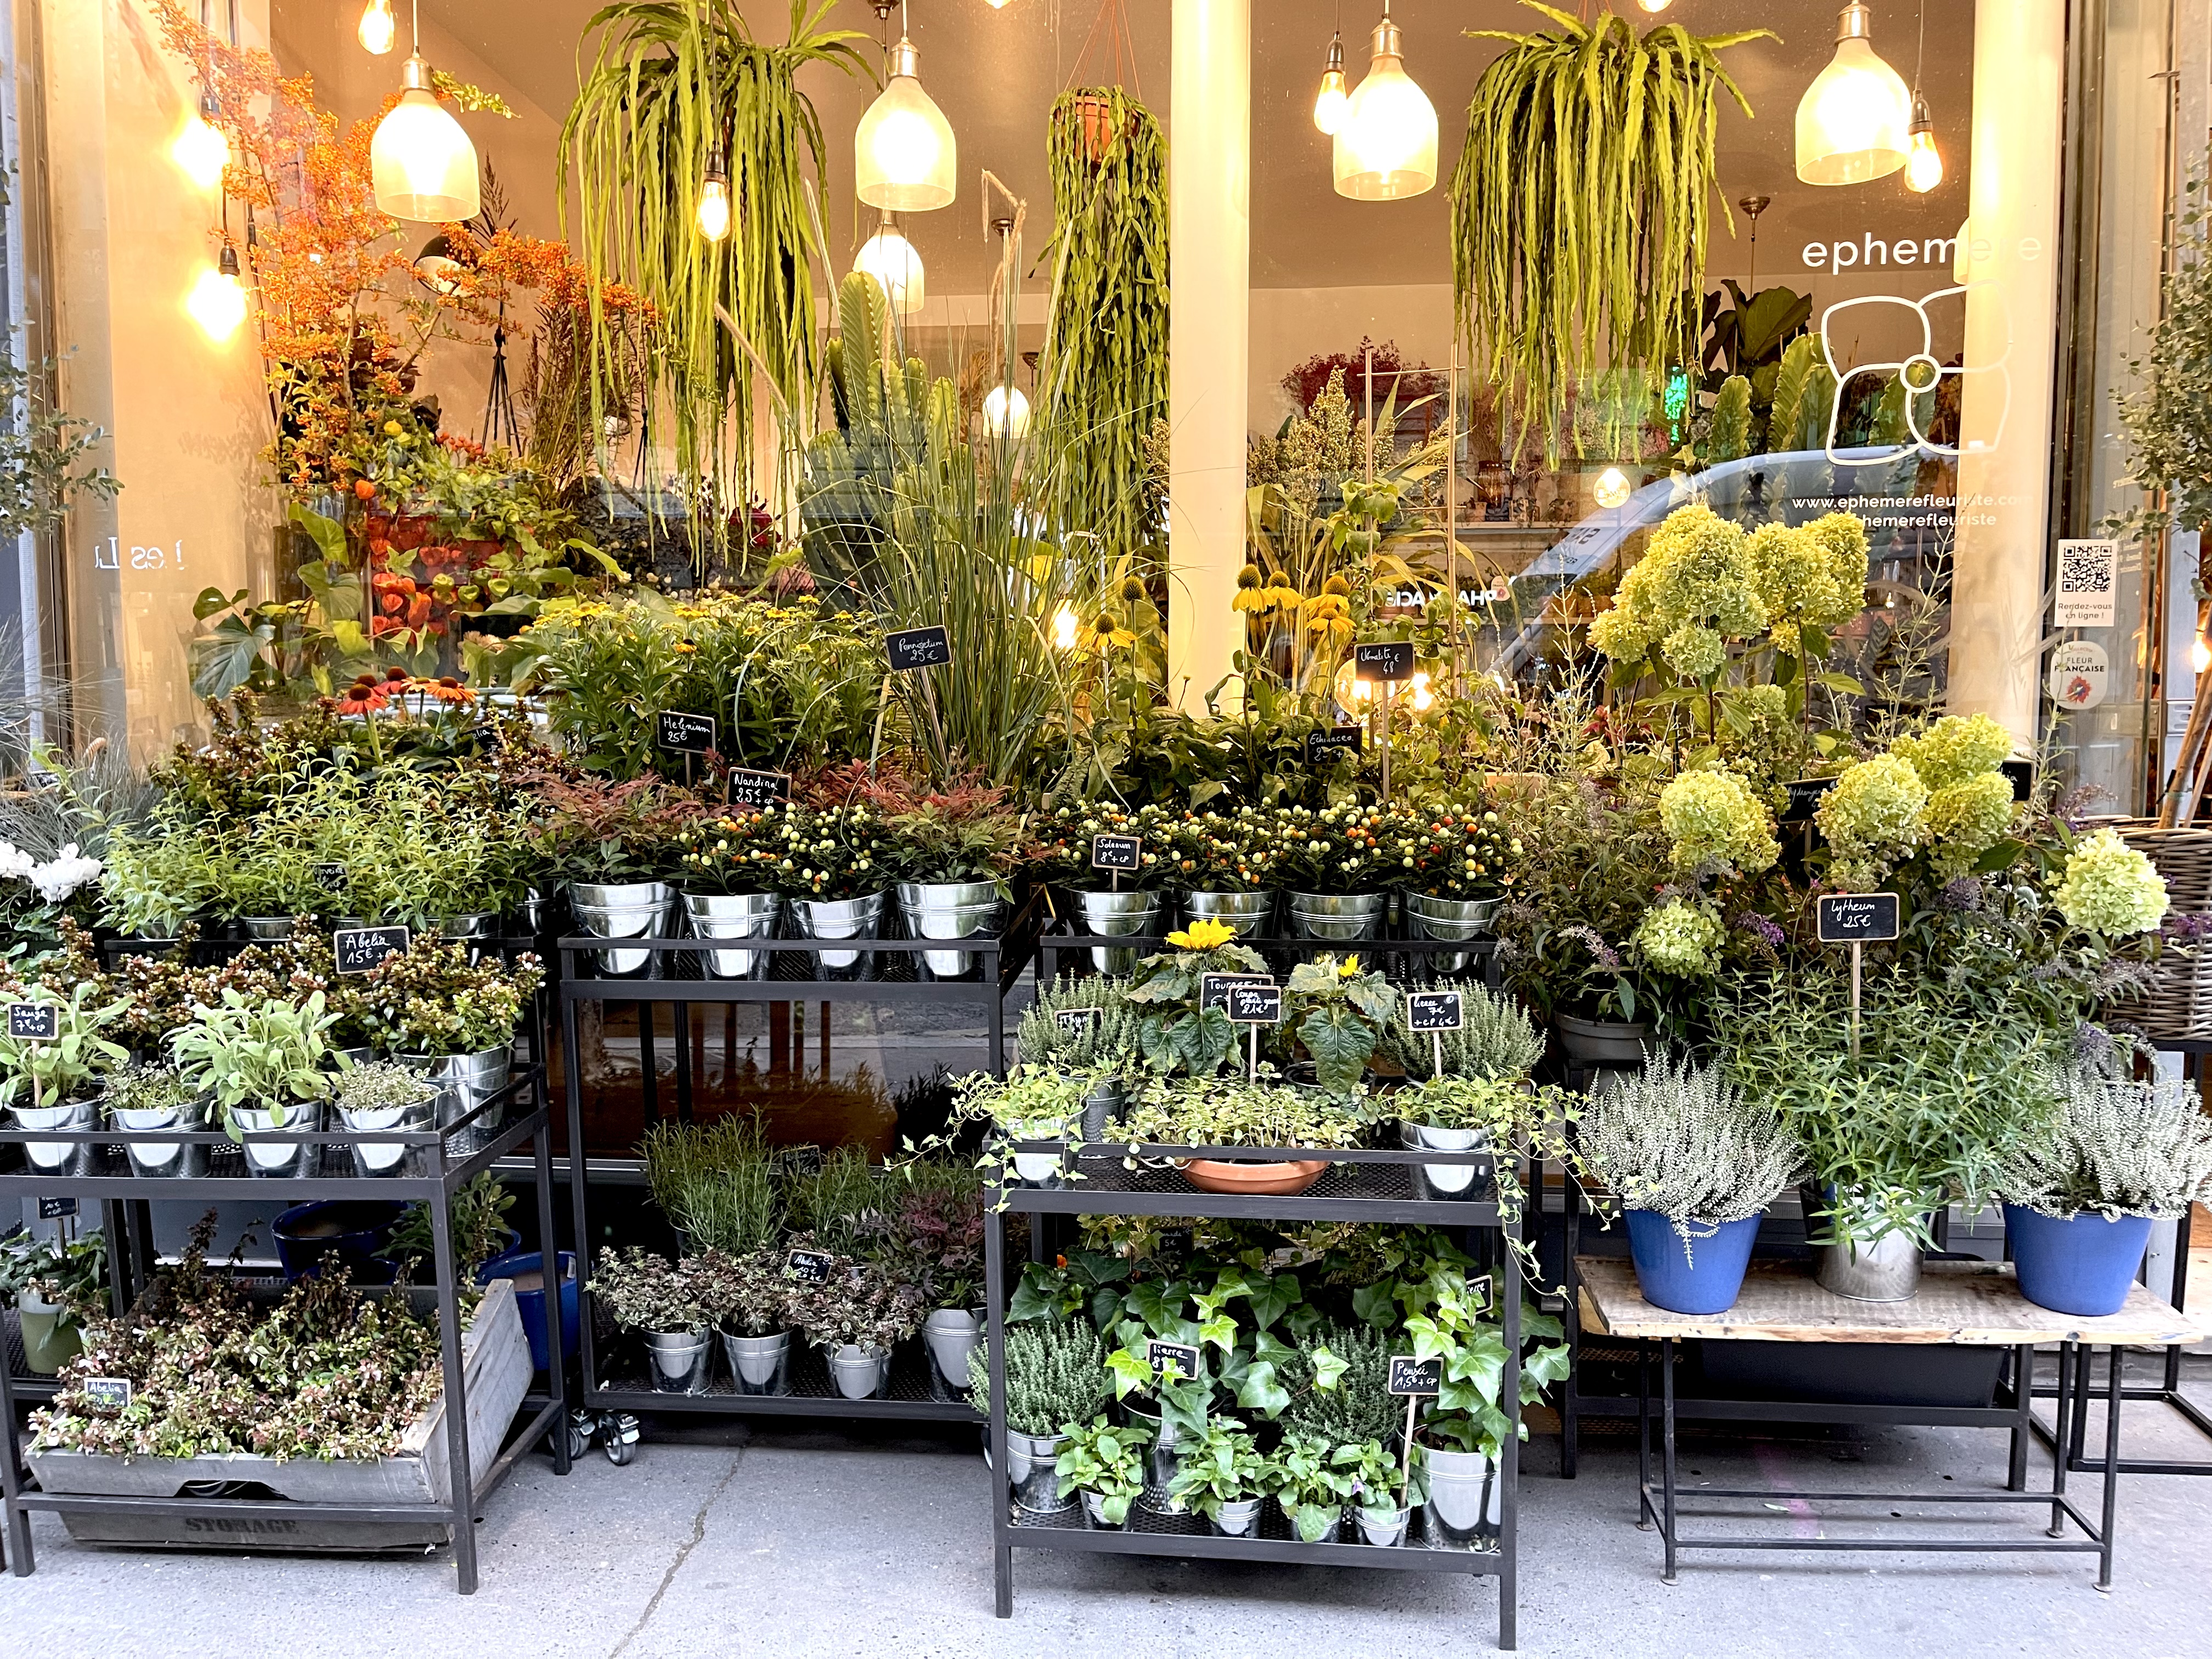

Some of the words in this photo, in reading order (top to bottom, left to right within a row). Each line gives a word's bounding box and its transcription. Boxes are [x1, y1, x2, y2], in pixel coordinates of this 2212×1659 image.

[2078, 612, 2099, 620] ligne
[668, 731, 687, 743] 25€
[734, 773, 778, 791] Nandina
[1097, 838, 1131, 849] Solanum
[1843, 915, 1871, 928] 25€
[346, 933, 391, 949] Abelia
[346, 948, 373, 963] 15€
[14, 1006, 48, 1021] Sauge
[1468, 1282, 1485, 1294] ierre
